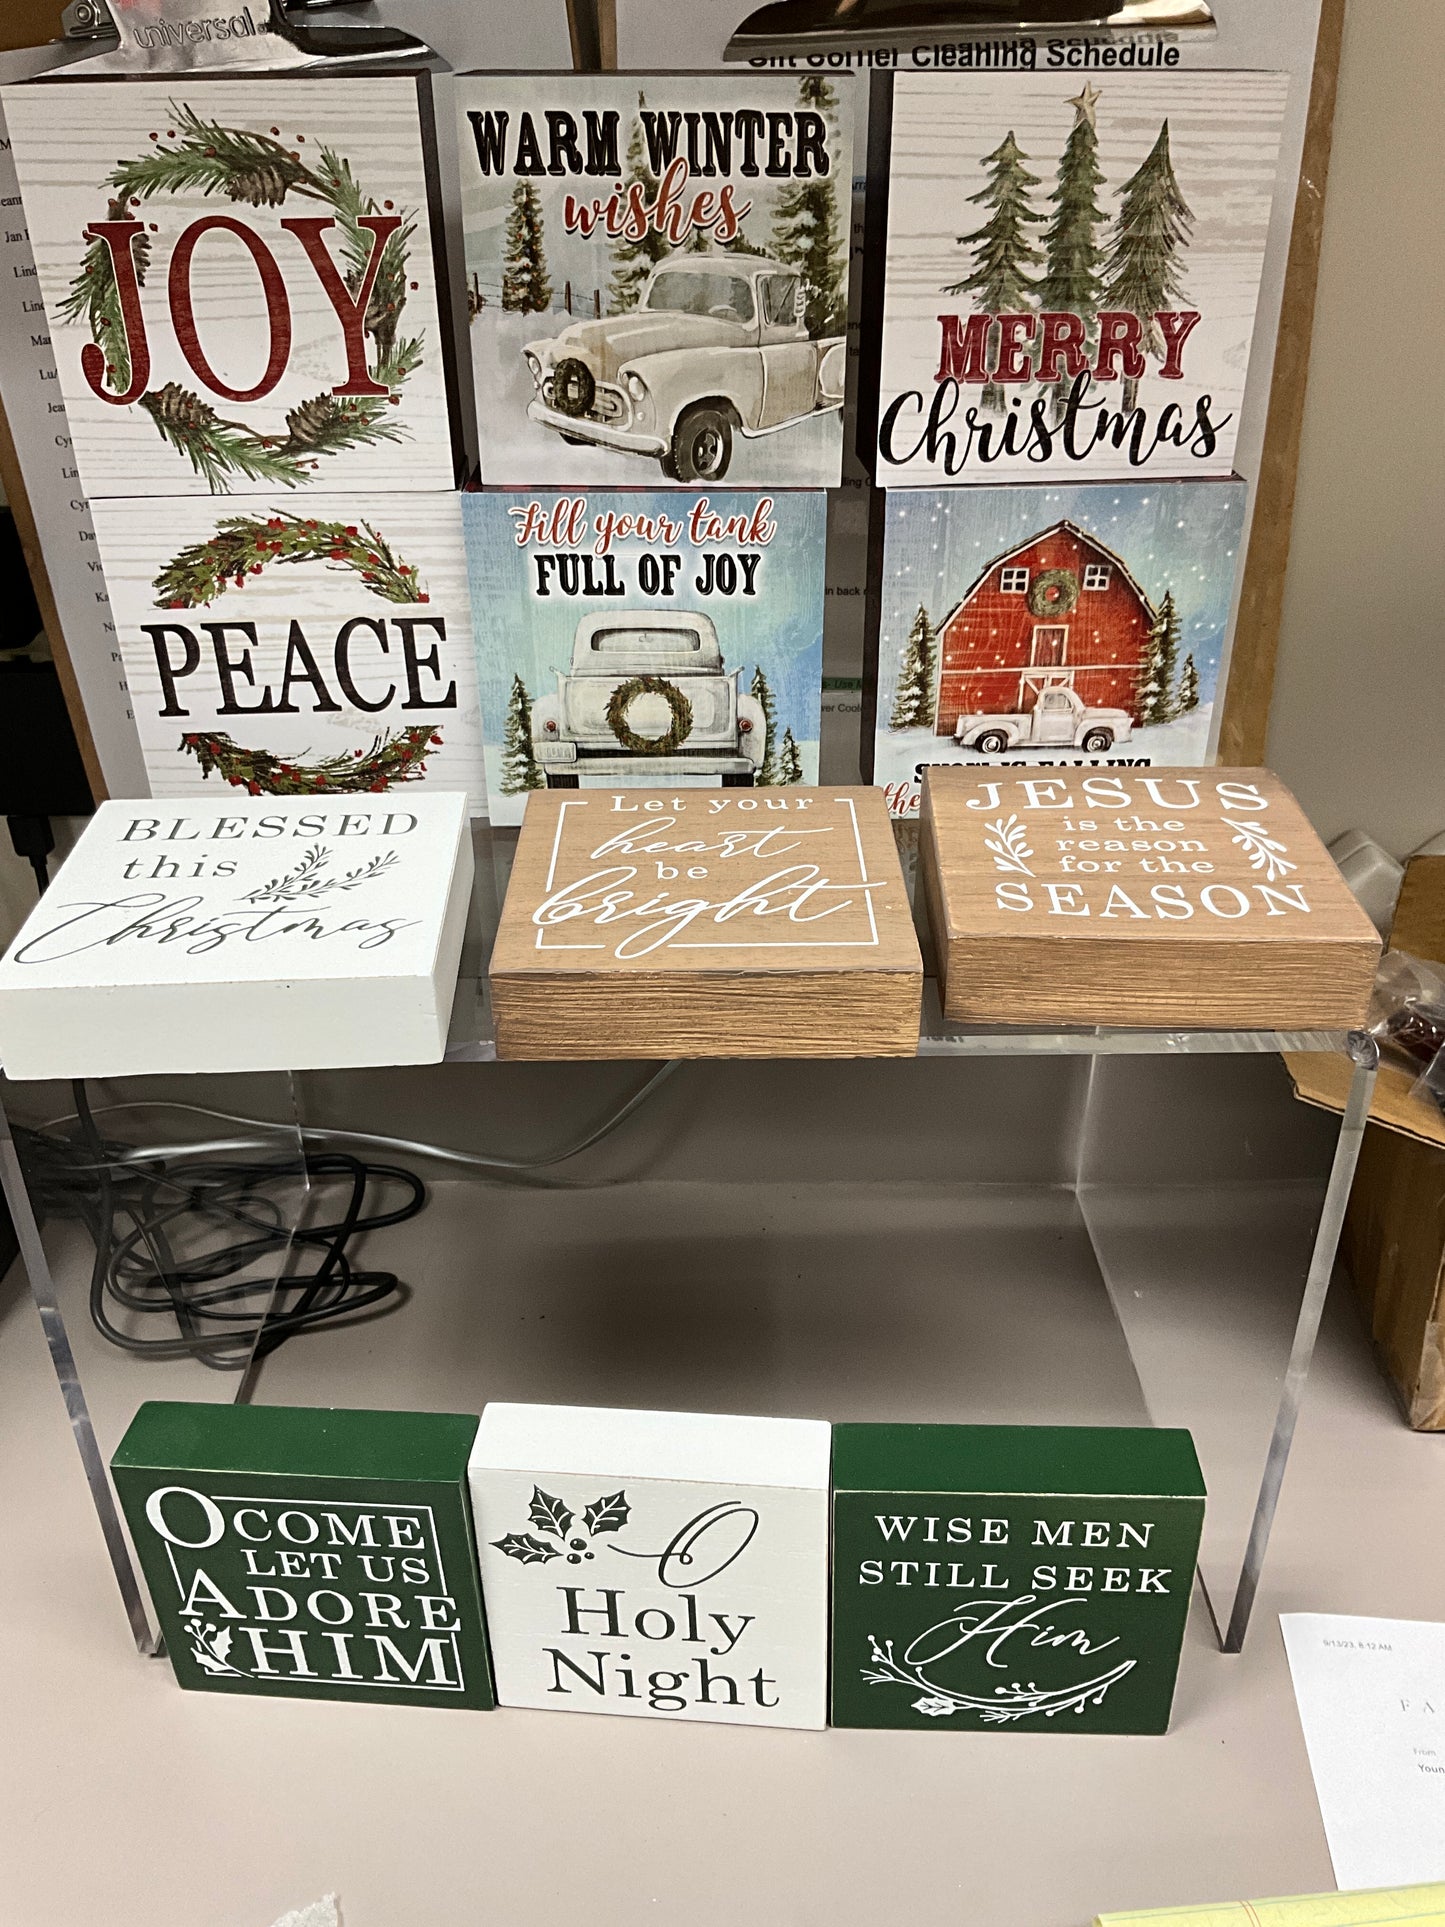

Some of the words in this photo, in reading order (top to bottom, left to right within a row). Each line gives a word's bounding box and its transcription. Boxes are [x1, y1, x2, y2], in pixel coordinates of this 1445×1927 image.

[911, 44, 1037, 69] Cleaning
[1046, 42, 1180, 67] Schedule
[467, 110, 622, 177] WARM
[640, 111, 830, 178] WINTER
[564, 157, 751, 246] wishes
[81, 215, 402, 405] JOY
[934, 311, 1201, 385] MERRY
[879, 370, 1232, 476] Christmas
[509, 498, 587, 546] Fill
[595, 507, 681, 554] your
[689, 498, 776, 546] tank
[534, 554, 625, 596] FULL
[638, 554, 681, 596] OF
[695, 553, 762, 596] JOY
[837, 586, 860, 596] back
[140, 617, 458, 718] PEACE
[610, 796, 687, 813] Let
[708, 797, 814, 814] your
[965, 777, 1269, 812] JESUS
[117, 813, 419, 842] BLESSED
[590, 817, 834, 860] heart
[1056, 836, 1208, 853] reason
[1063, 815, 1099, 832] is
[1113, 815, 1186, 832] the
[123, 854, 239, 880] this
[656, 861, 709, 880] be
[1058, 855, 1130, 873] for
[1138, 856, 1216, 874] the
[532, 864, 887, 960] bright
[996, 882, 1313, 920] SEASON
[14, 893, 423, 964] Christmas
[145, 1486, 226, 1549] O
[233, 1508, 426, 1550] COME
[874, 1515, 1010, 1545] WISE
[1031, 1520, 1155, 1549] MEN
[240, 1549, 342, 1580] LET
[357, 1555, 430, 1584] US
[607, 1501, 759, 1588] O
[178, 1568, 462, 1632] ADORE
[859, 1560, 1010, 1589] STILL
[1031, 1565, 1172, 1594] SEEK
[556, 1586, 756, 1656] Holy
[904, 1595, 1120, 1668] Him
[238, 1626, 458, 1685] HIM
[542, 1648, 780, 1711] Night
